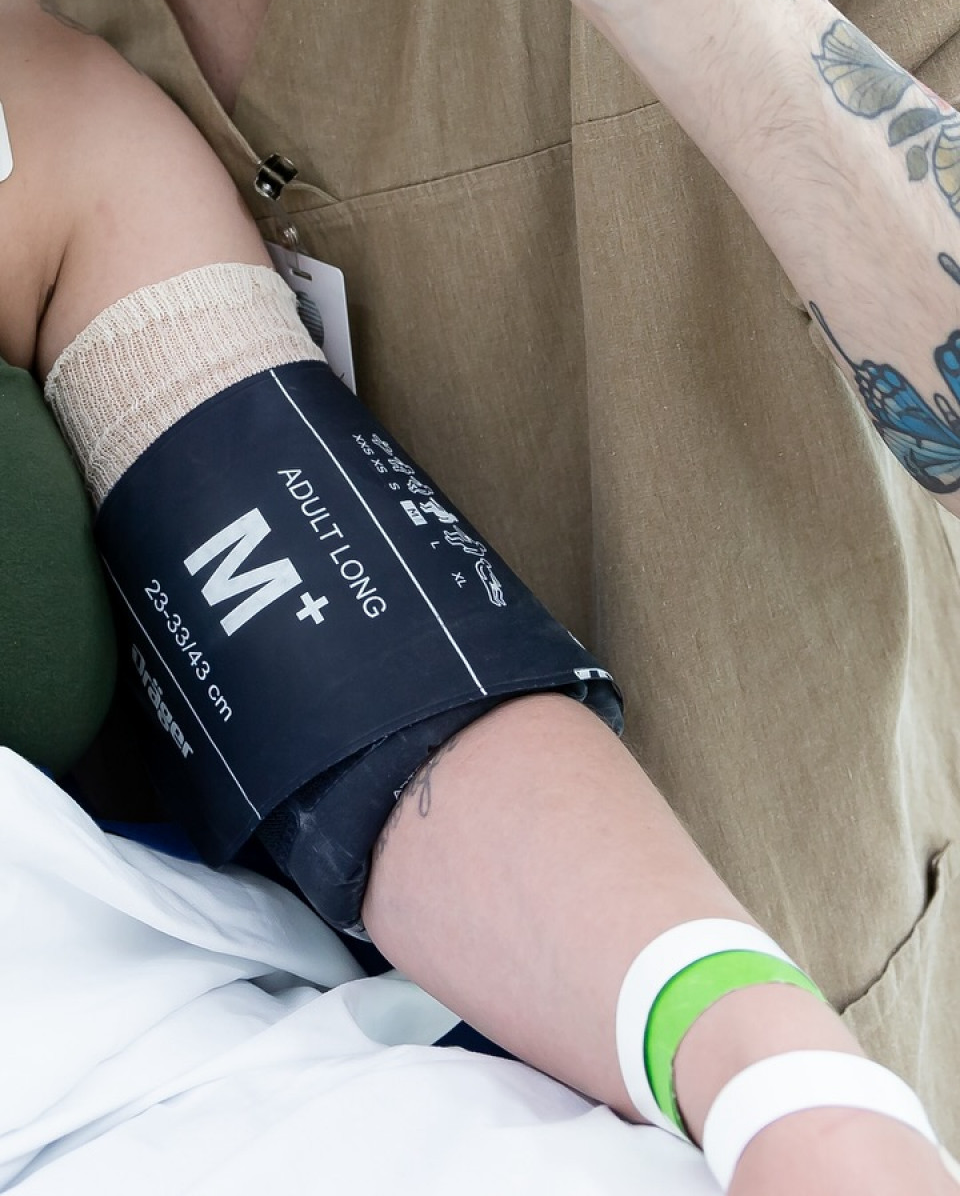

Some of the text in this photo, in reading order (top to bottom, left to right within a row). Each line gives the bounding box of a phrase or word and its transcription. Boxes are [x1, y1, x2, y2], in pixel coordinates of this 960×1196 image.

[276, 468, 387, 619] ADULT LONG
[352, 432, 376, 456] XXS
[370, 457, 389, 474] XS
[388, 481, 401, 492] S
[430, 540, 441, 550] L
[451, 571, 468, 589] XL
[144, 578, 233, 722] 23-33/43 cm
